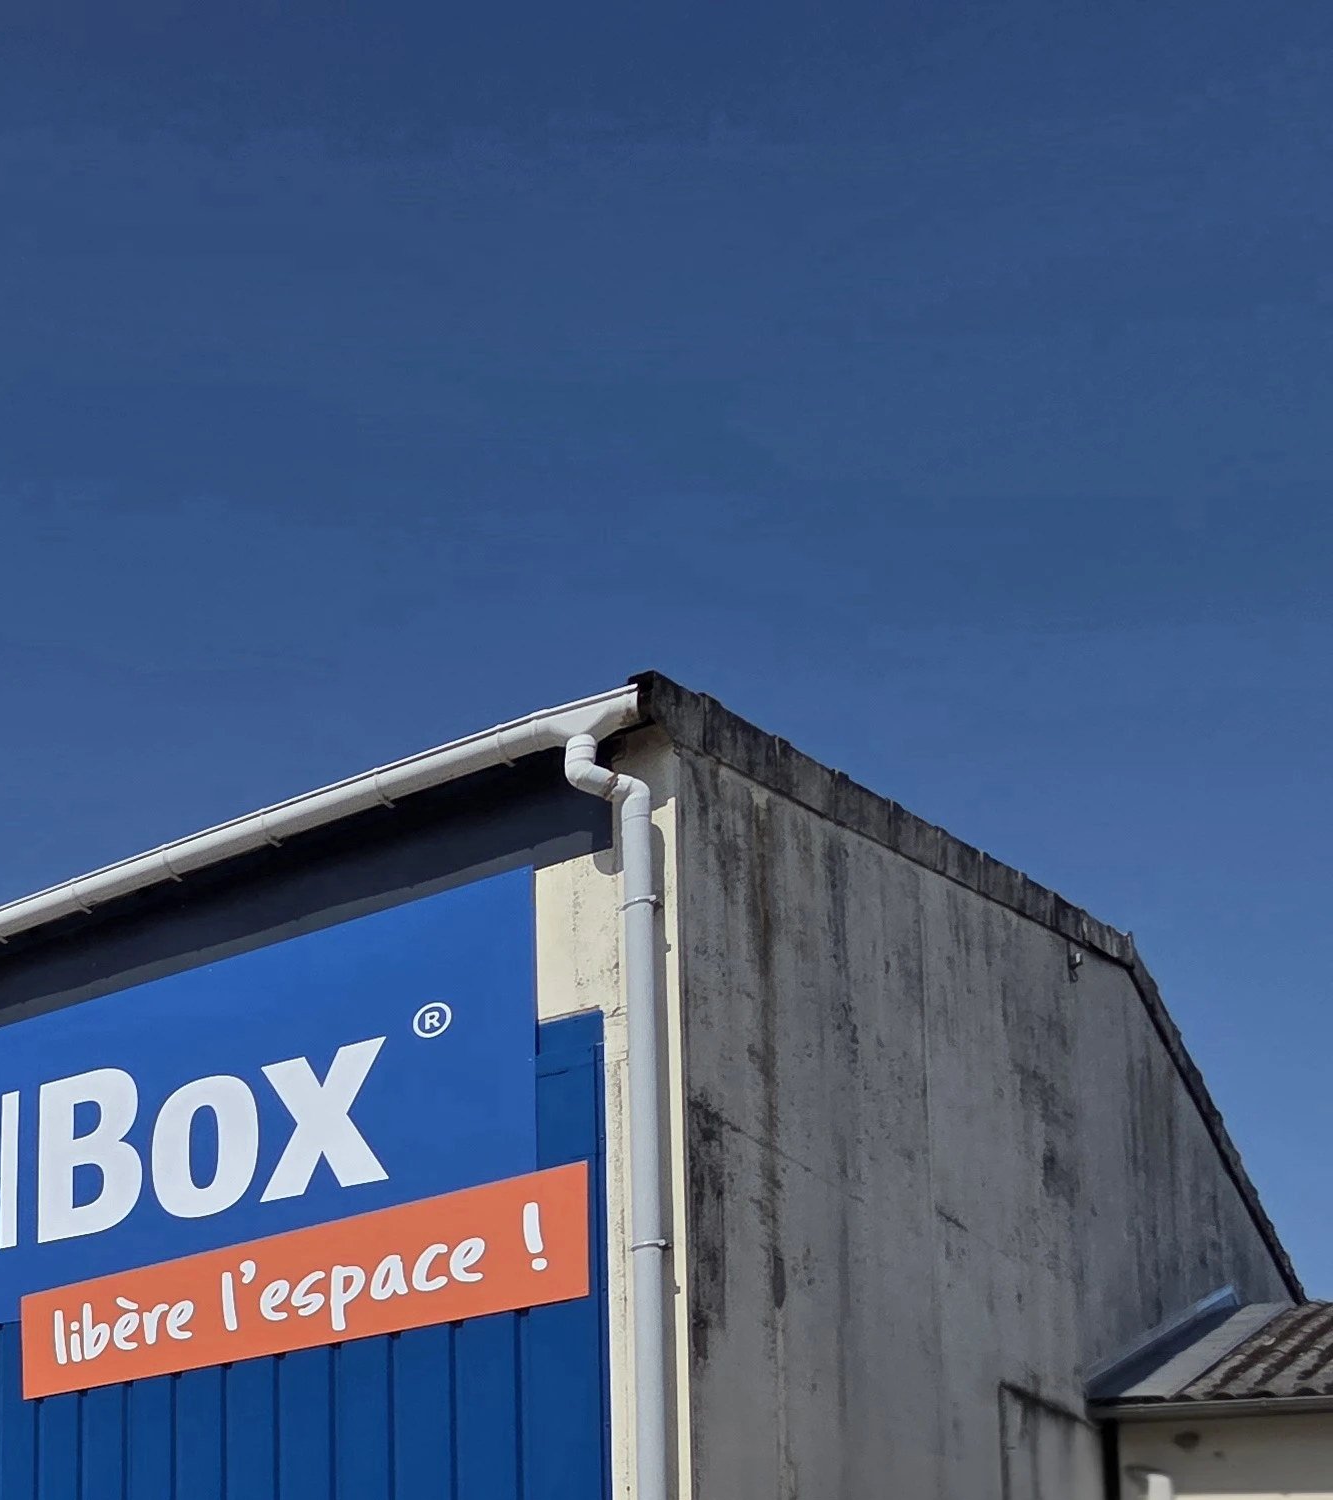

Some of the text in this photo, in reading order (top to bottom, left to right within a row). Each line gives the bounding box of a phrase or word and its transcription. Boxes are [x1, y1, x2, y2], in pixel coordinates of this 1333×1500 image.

[53, 1201, 547, 1366] libère l'espace !
